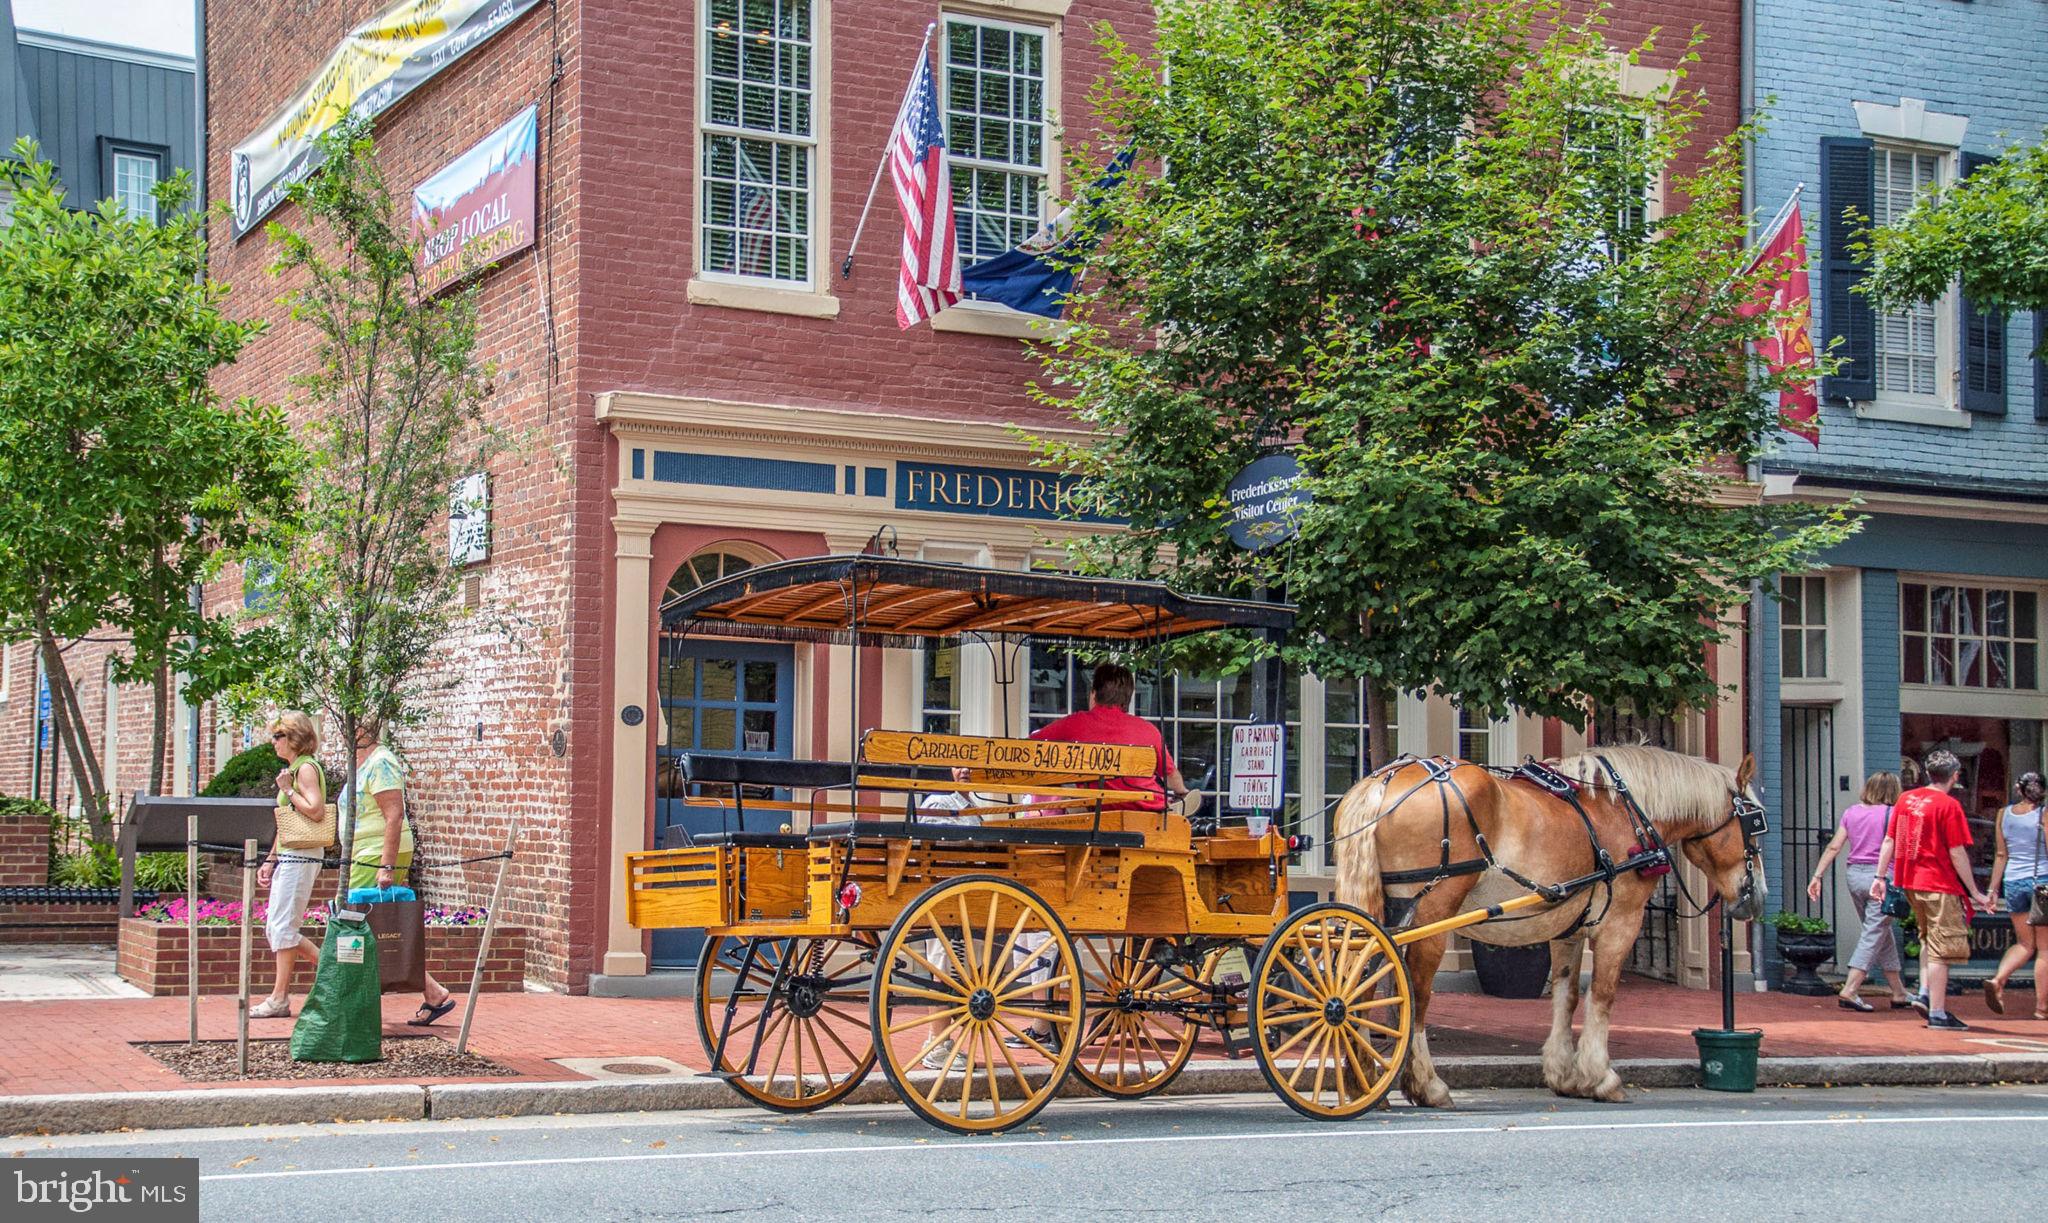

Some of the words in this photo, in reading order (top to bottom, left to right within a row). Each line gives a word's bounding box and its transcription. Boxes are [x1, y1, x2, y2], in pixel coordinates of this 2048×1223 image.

[460, 193, 512, 246] LOCAL
[1235, 728, 1245, 743] NO
[1248, 726, 1280, 743] PARKING
[1241, 746, 1272, 757] CARRIAGE
[1247, 760, 1265, 770] STAND
[1243, 782, 1268, 793] TOWING
[1238, 795, 1272, 806] ENFORCED
